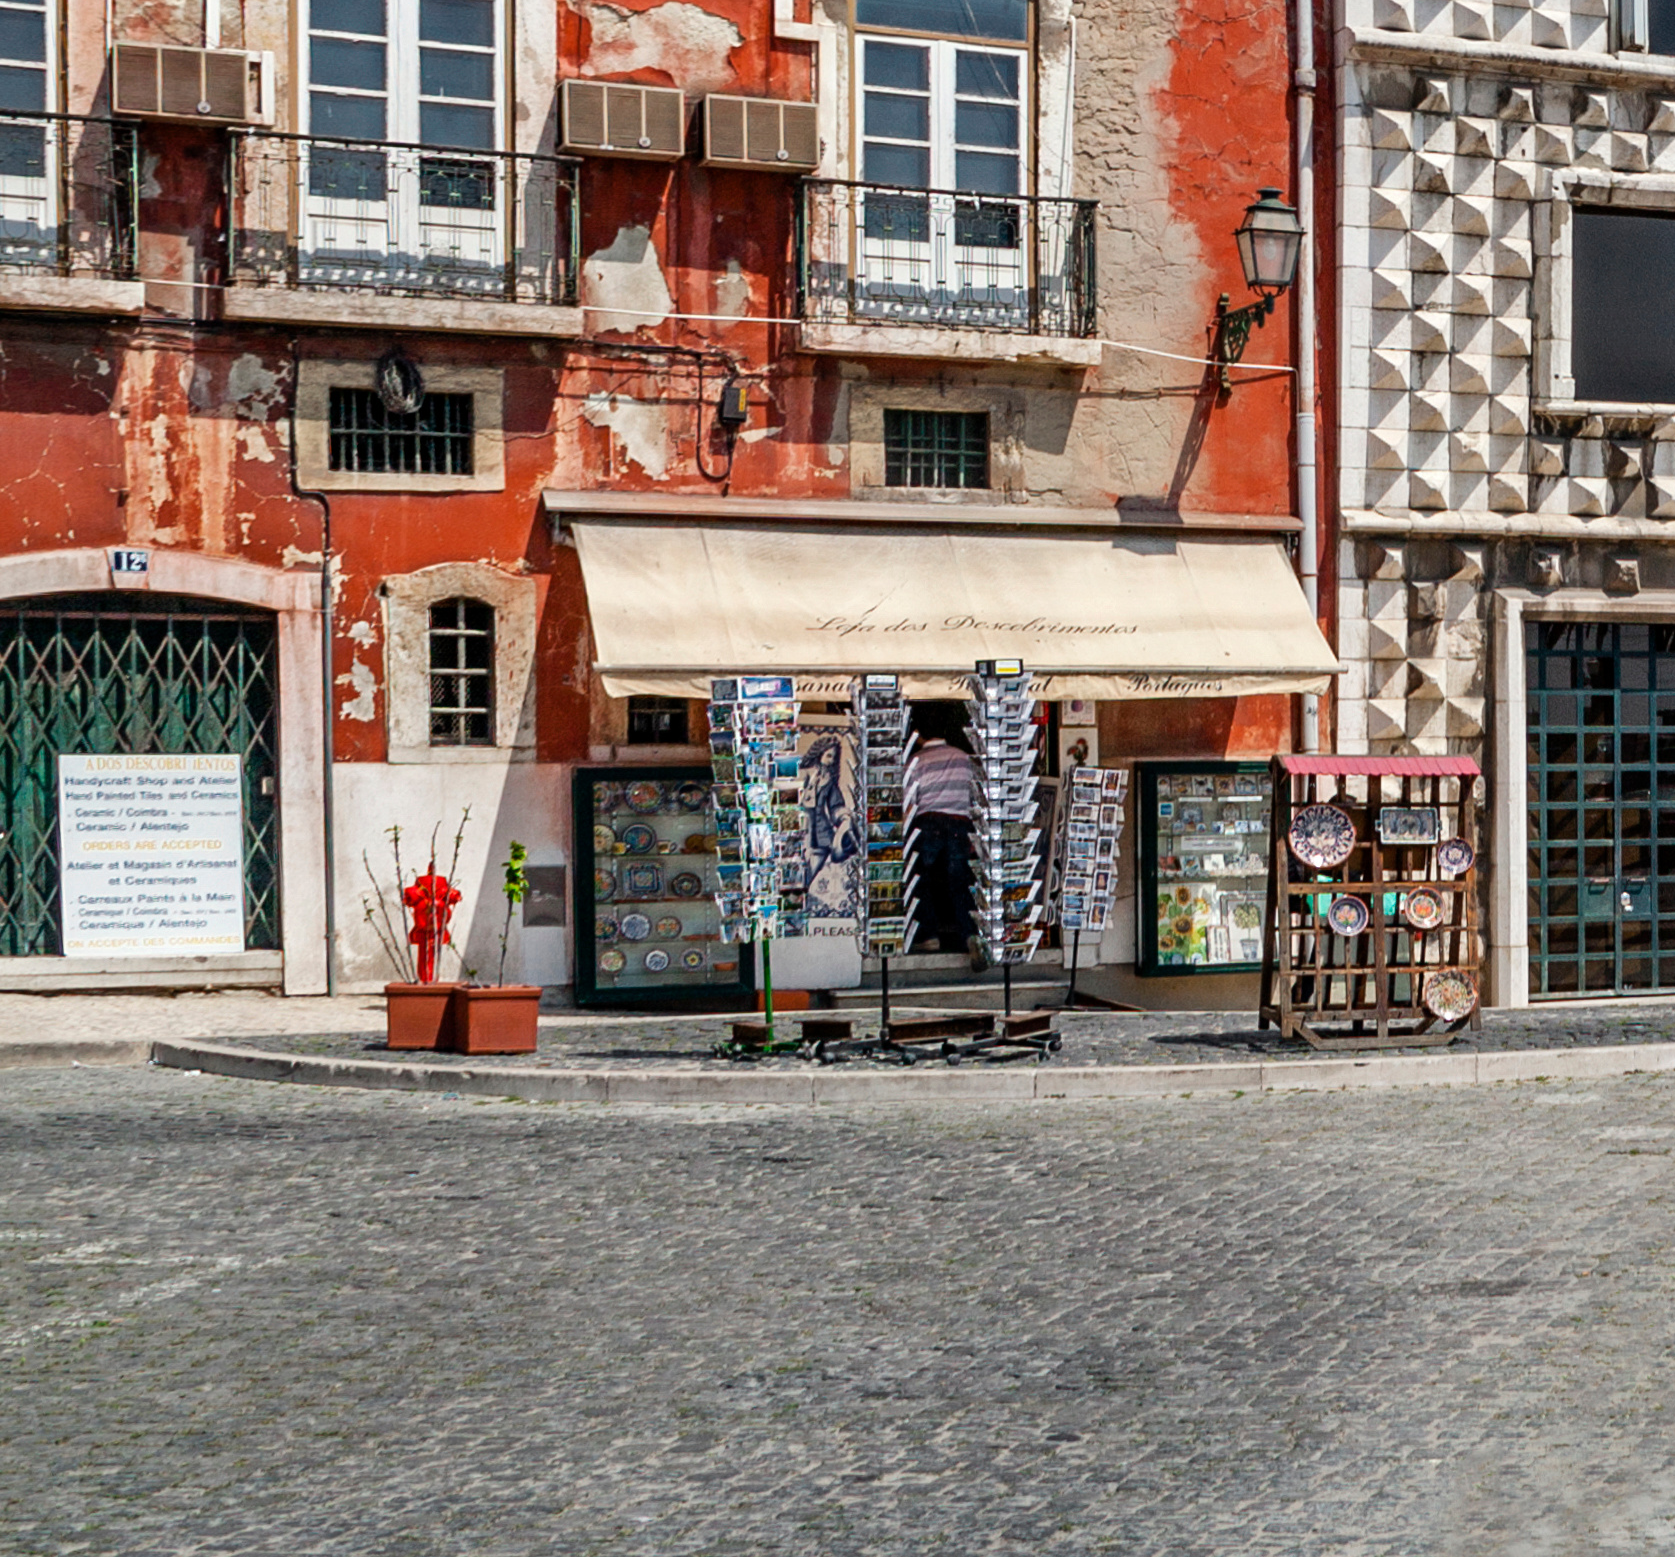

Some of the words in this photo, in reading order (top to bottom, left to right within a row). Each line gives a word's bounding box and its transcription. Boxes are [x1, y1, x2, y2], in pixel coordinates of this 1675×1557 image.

[883, 618, 928, 632] dos
[97, 757, 122, 771] DOS
[137, 777, 168, 787] Shop
[172, 777, 194, 785] and
[200, 776, 238, 785] Atelier
[66, 792, 93, 800] Hand
[97, 792, 136, 800] Painted
[168, 792, 188, 800] and
[191, 791, 238, 800] Ceramics
[75, 808, 115, 817] Ceramic
[76, 822, 126, 831] Ceramic
[83, 841, 131, 851] ORDERS
[135, 841, 158, 850] ARE
[162, 839, 222, 849] ACCEPTED
[67, 861, 104, 870] Atelier
[108, 861, 119, 869] et
[108, 877, 120, 885] et
[192, 893, 202, 901] la
[206, 893, 236, 901] Main
[88, 939, 139, 947] ACCEPTE
[143, 937, 166, 946] DES
